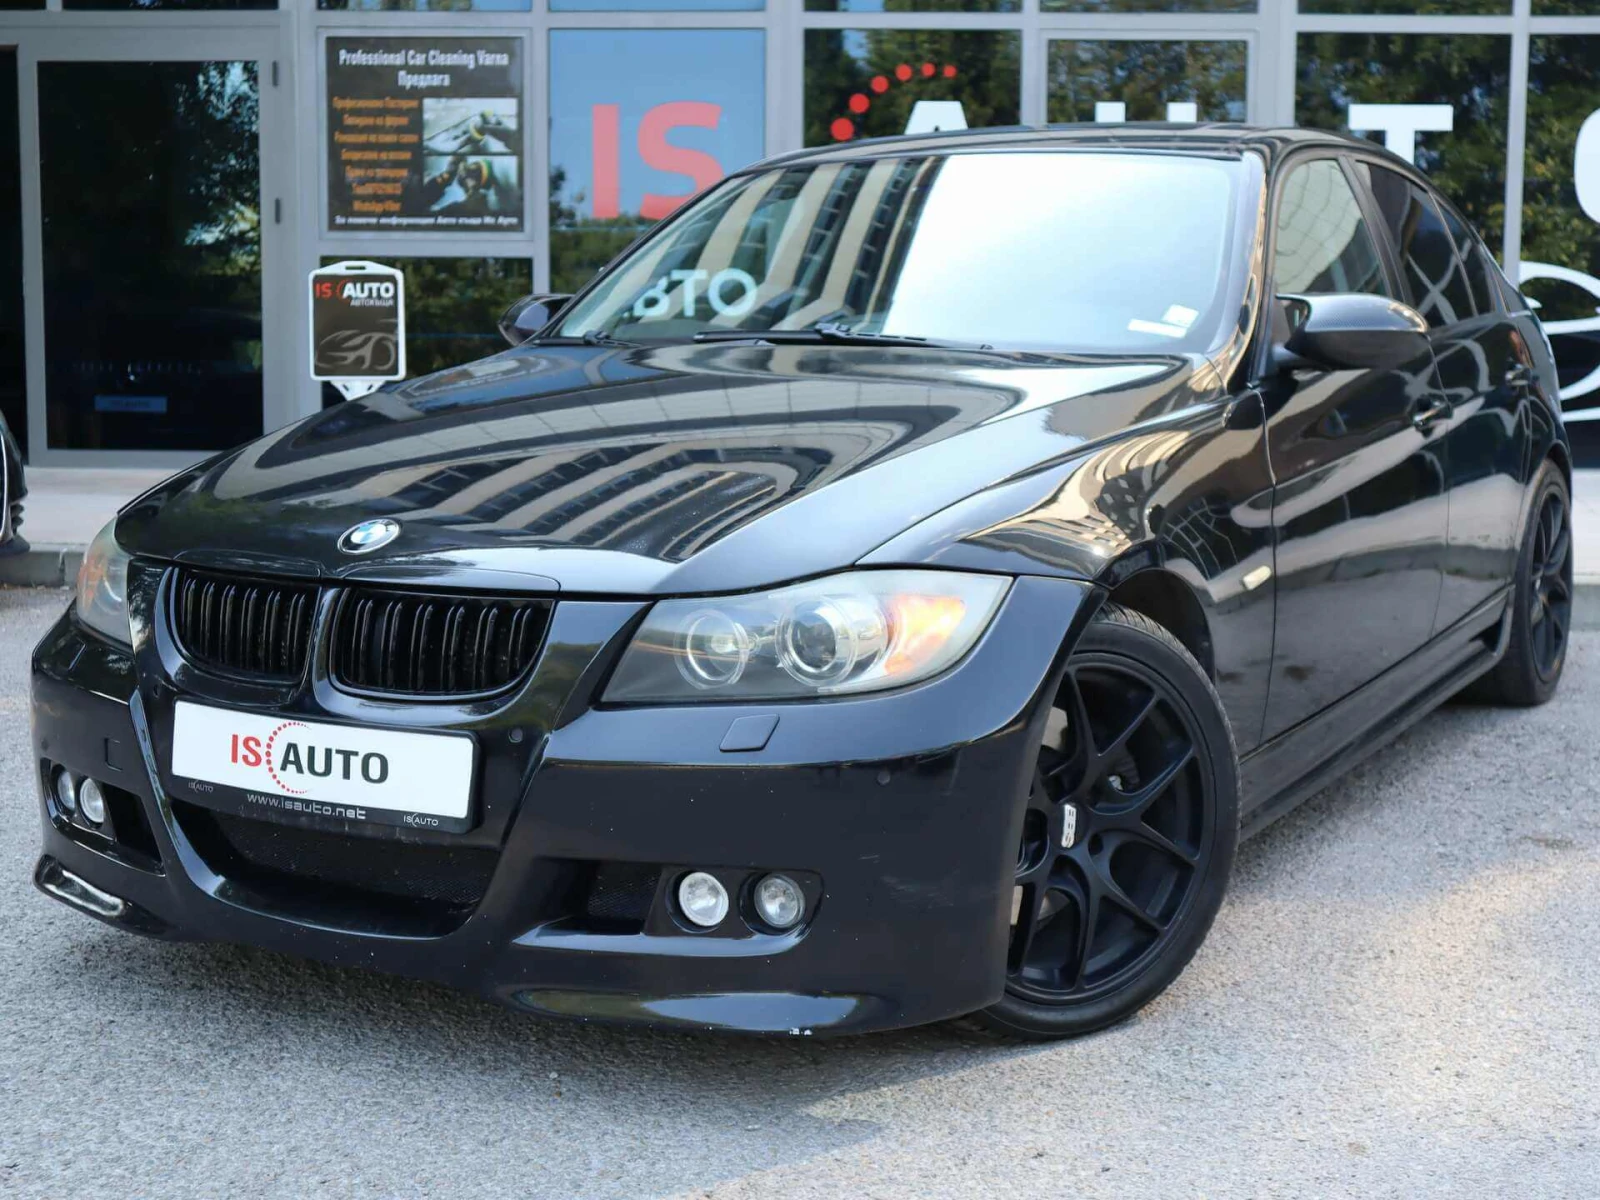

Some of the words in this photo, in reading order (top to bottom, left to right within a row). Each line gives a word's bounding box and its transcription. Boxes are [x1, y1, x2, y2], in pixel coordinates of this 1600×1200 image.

[339, 50, 405, 66] Professional
[407, 50, 426, 66] Car
[428, 50, 475, 69] Cleaning
[477, 50, 509, 66] Varna
[593, 101, 725, 219] IS
[315, 283, 332, 298] IS
[342, 282, 394, 298] AUTO
[231, 734, 262, 767] IS
[280, 742, 389, 784] AUTO
[247, 794, 366, 819] www.isauto.net
[414, 817, 439, 826] AUTO
